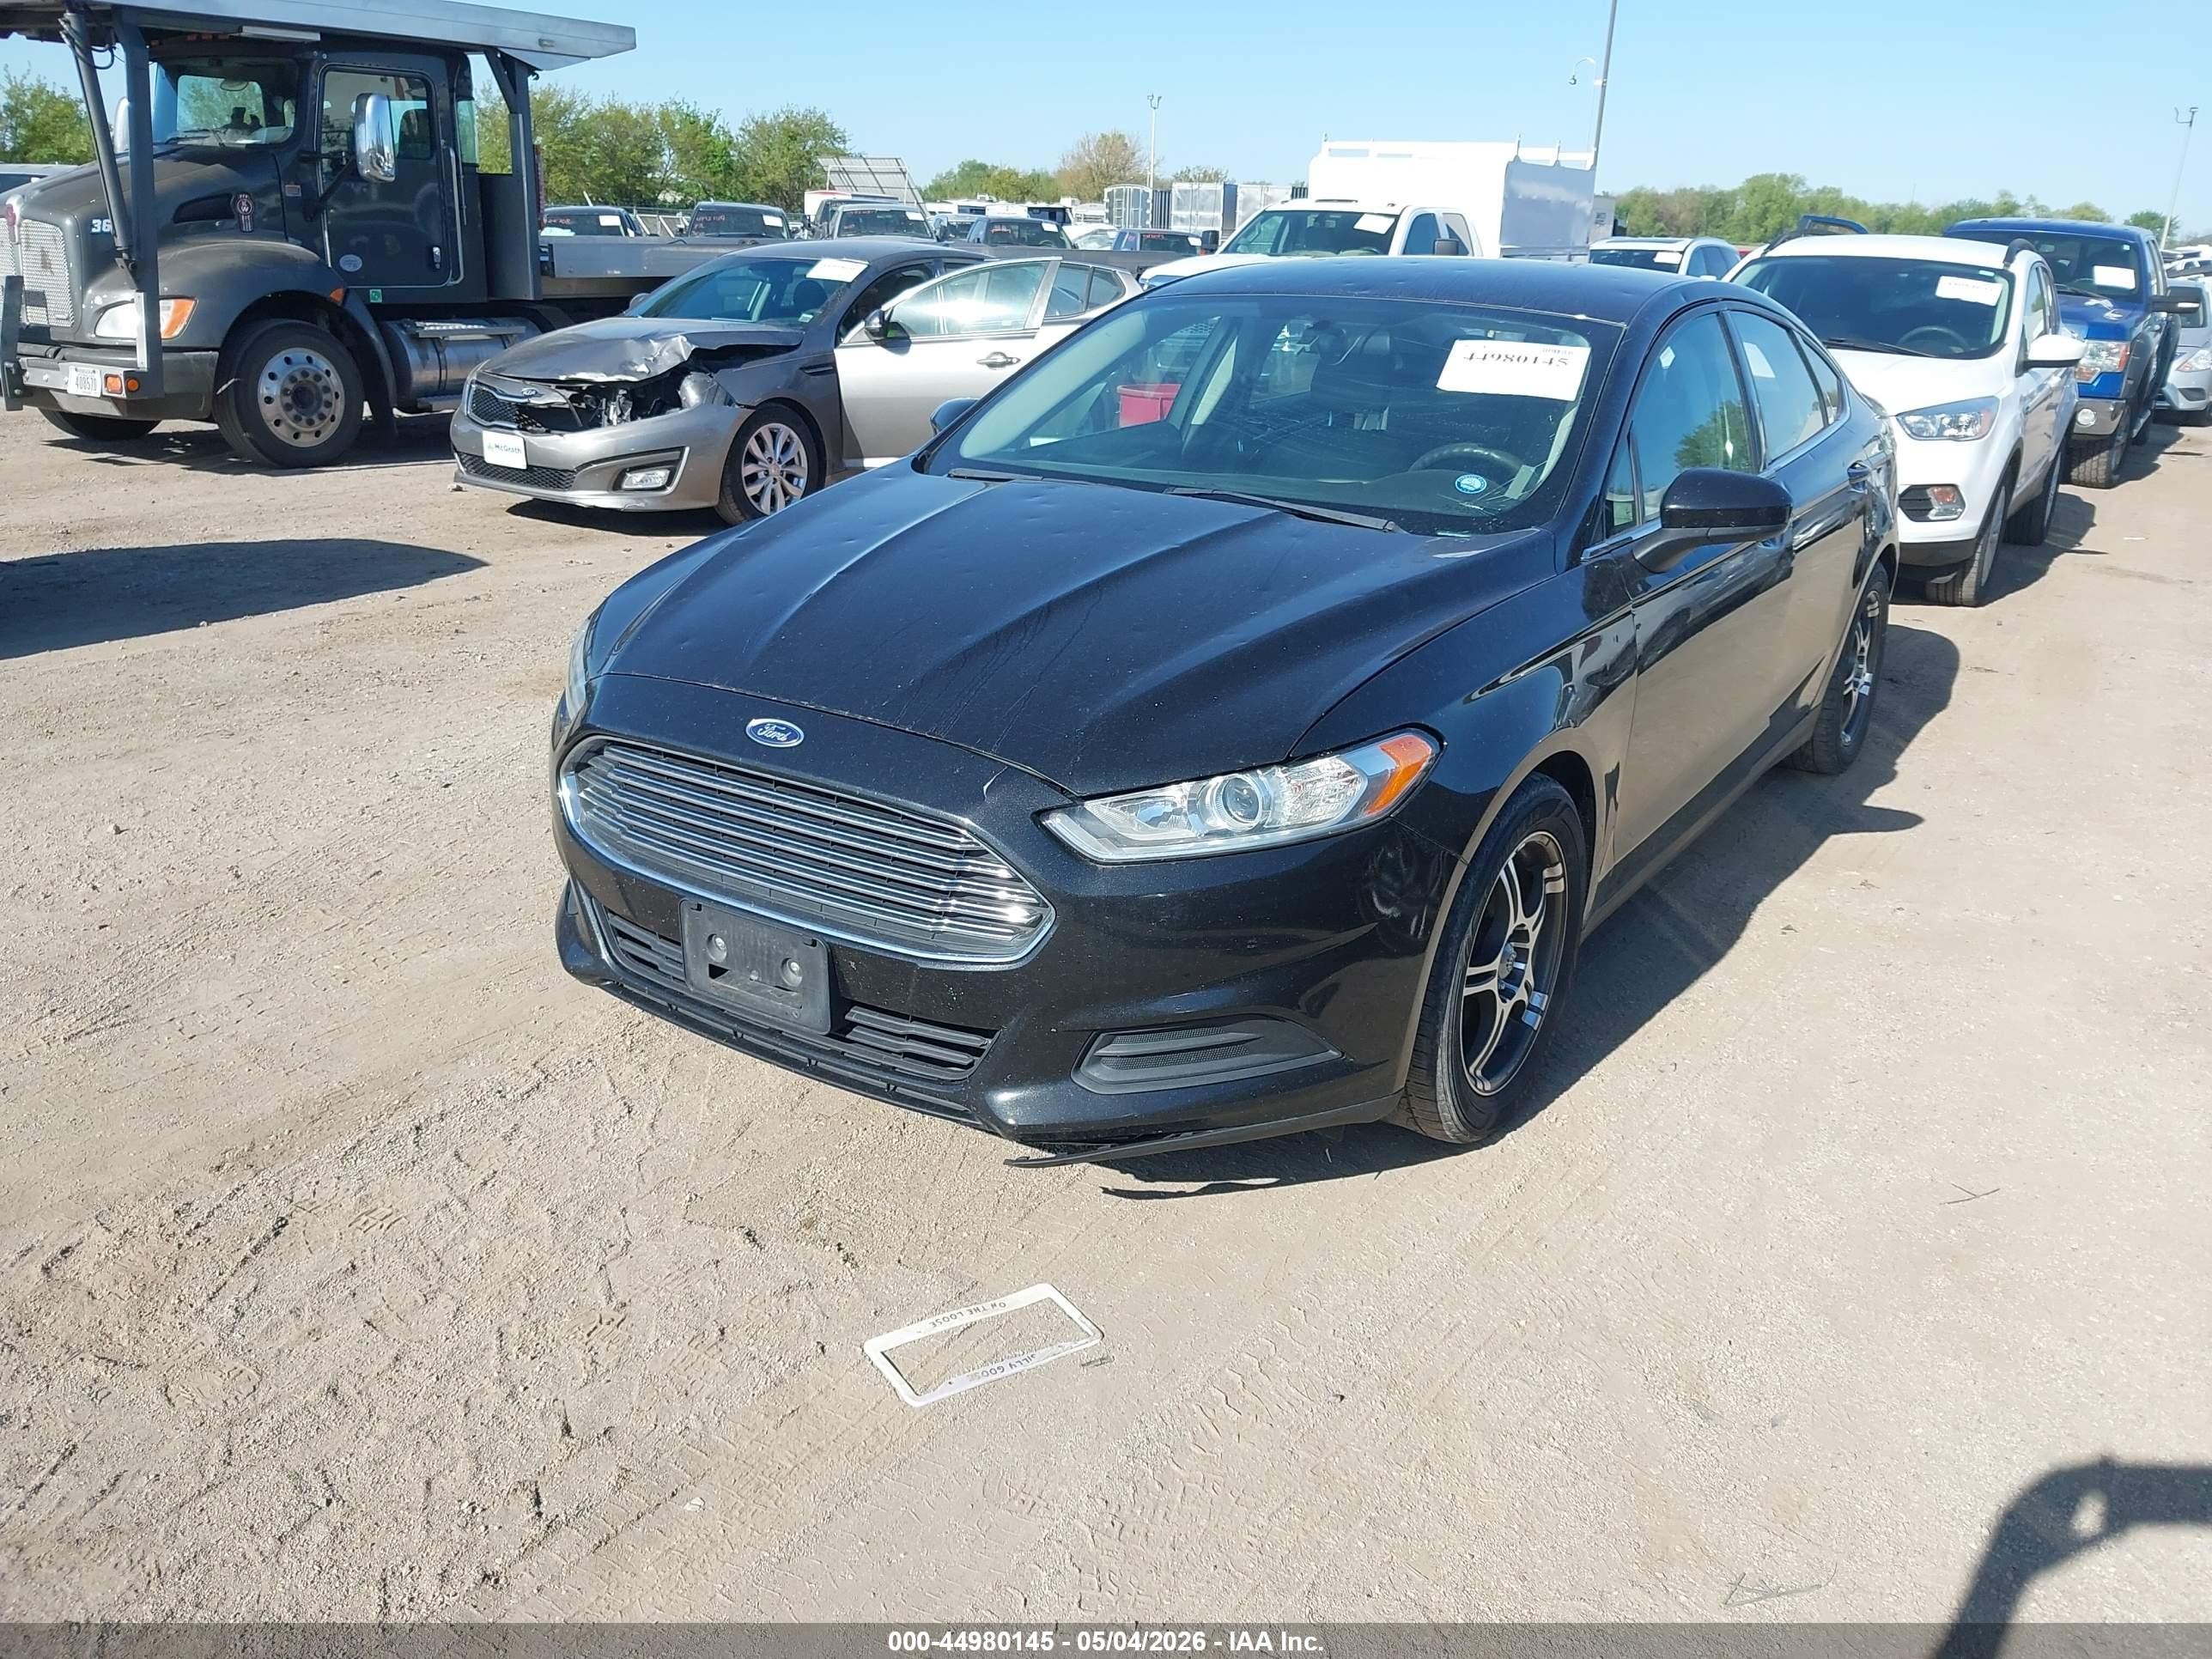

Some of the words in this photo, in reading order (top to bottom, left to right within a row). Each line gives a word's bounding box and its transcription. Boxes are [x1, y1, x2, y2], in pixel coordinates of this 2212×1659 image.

[495, 443, 521, 454] McGrath
[757, 723, 792, 741] Ford
[966, 1304, 989, 1316] THE
[928, 1310, 963, 1328] LOOSE
